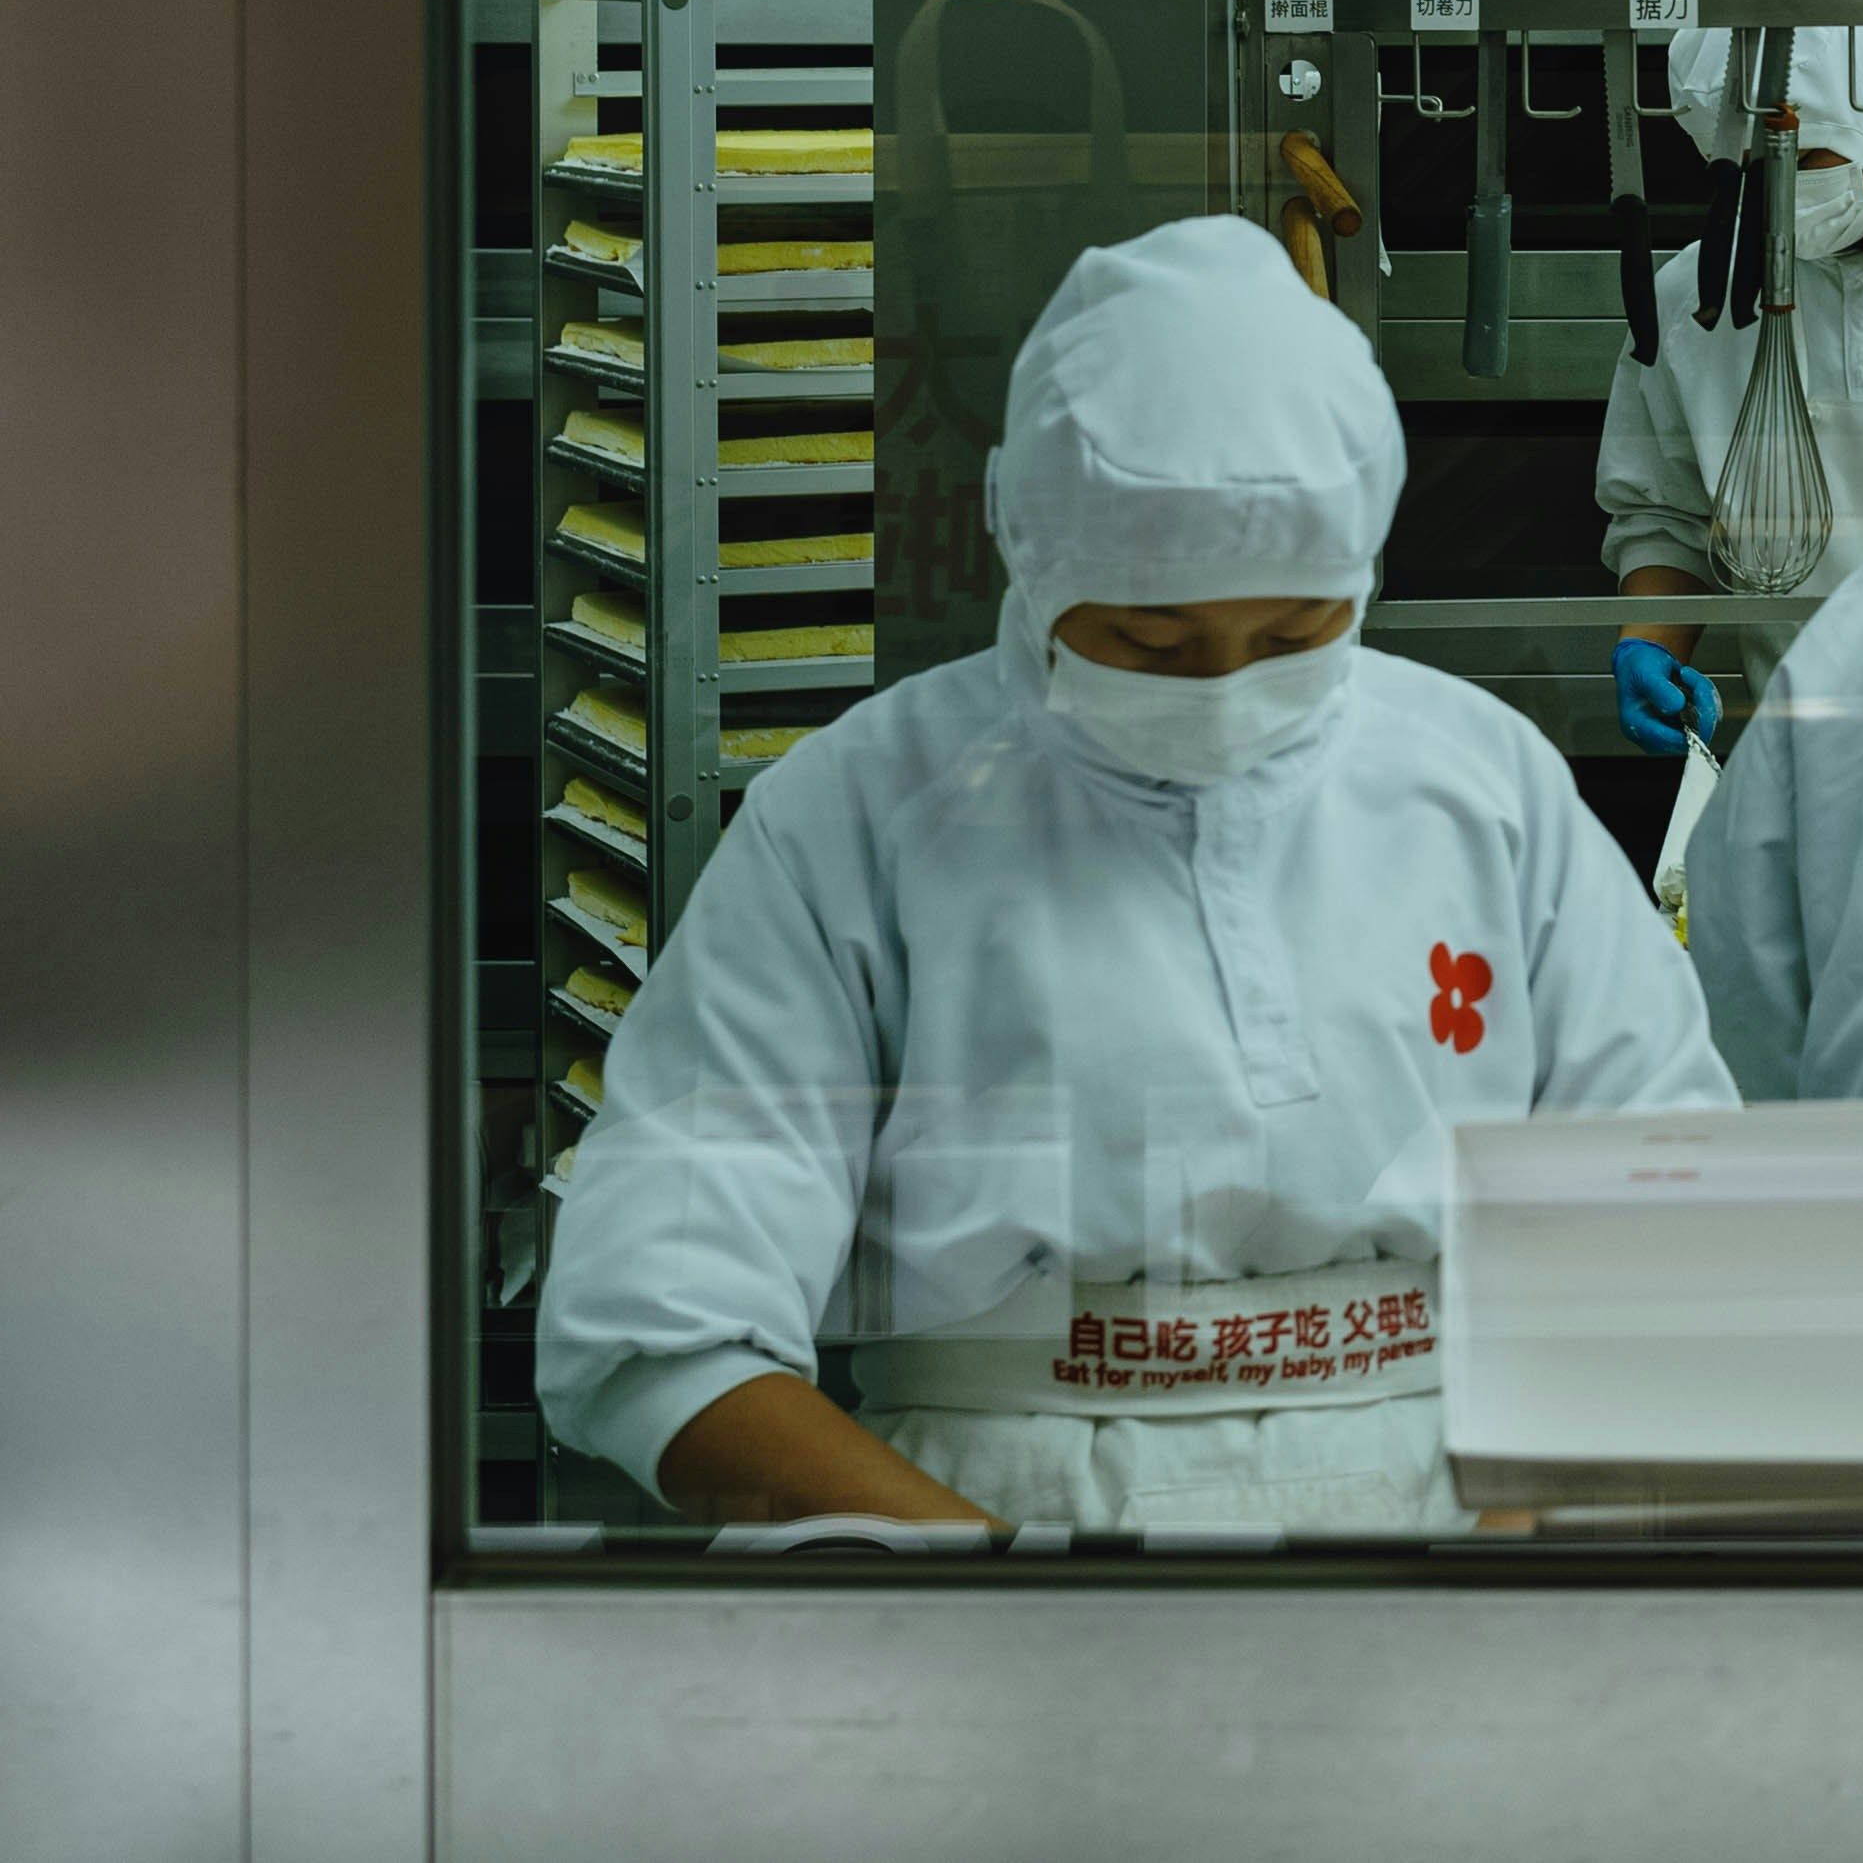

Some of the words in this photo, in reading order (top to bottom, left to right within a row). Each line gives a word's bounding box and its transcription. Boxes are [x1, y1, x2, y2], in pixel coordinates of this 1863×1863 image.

[1270, 0, 1329, 20] 擀面棍
[1069, 1311, 1198, 1362] 自己吃
[1212, 1304, 1331, 1360] 孩子吃
[1343, 1287, 1430, 1345] 父母吃
[1053, 1359, 1091, 1385] Eat
[1094, 1360, 1135, 1388] for
[1143, 1359, 1231, 1389] myself,
[1238, 1360, 1275, 1388] my
[1280, 1354, 1336, 1382] baby,
[1343, 1349, 1374, 1376] my
